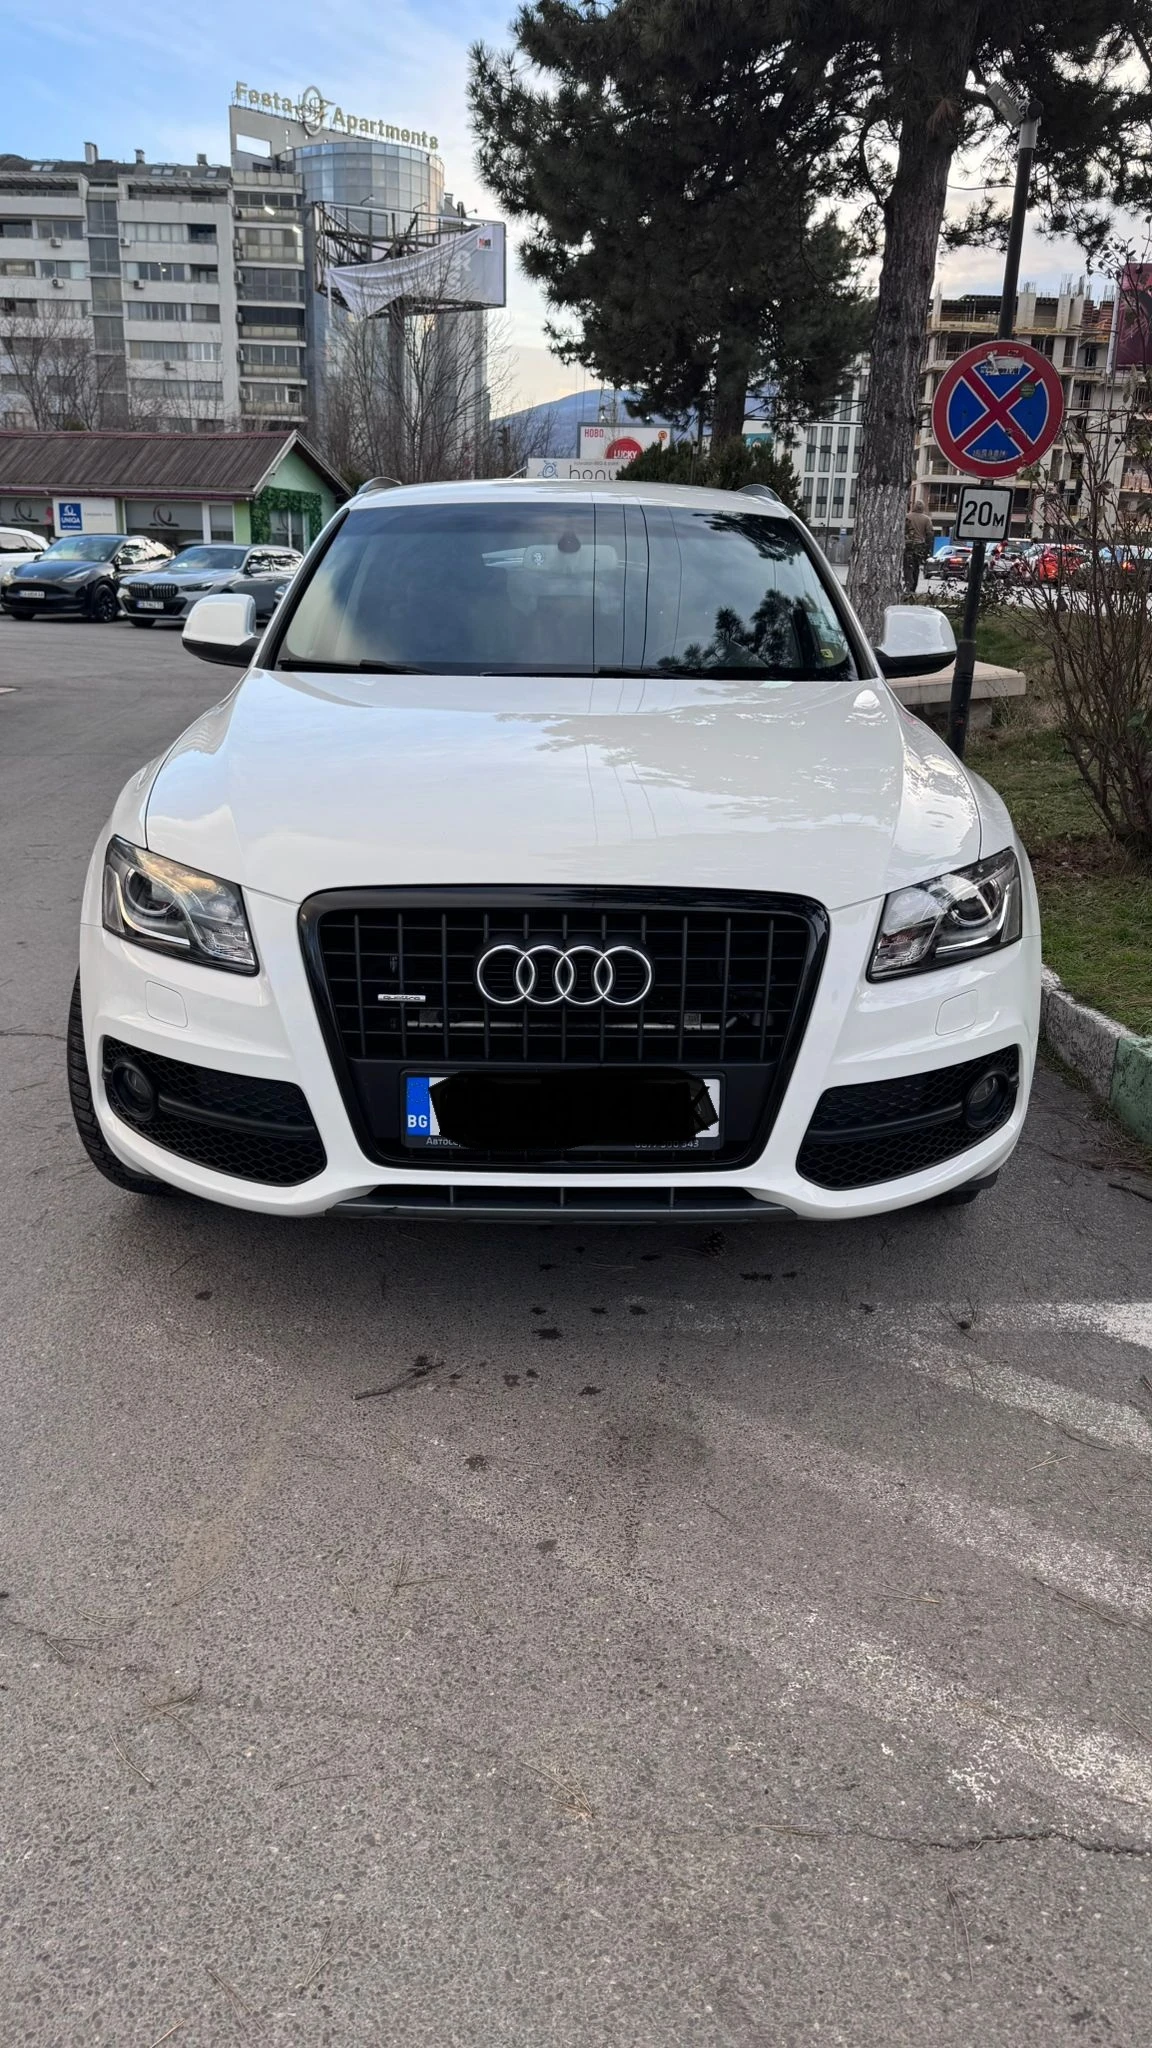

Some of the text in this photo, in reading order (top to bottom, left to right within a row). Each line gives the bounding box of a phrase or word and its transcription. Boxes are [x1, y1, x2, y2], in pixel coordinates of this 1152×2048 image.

[235, 80, 439, 150] Festa Apartments
[613, 450, 638, 459] LUCKY
[407, 1114, 428, 1128] BG
